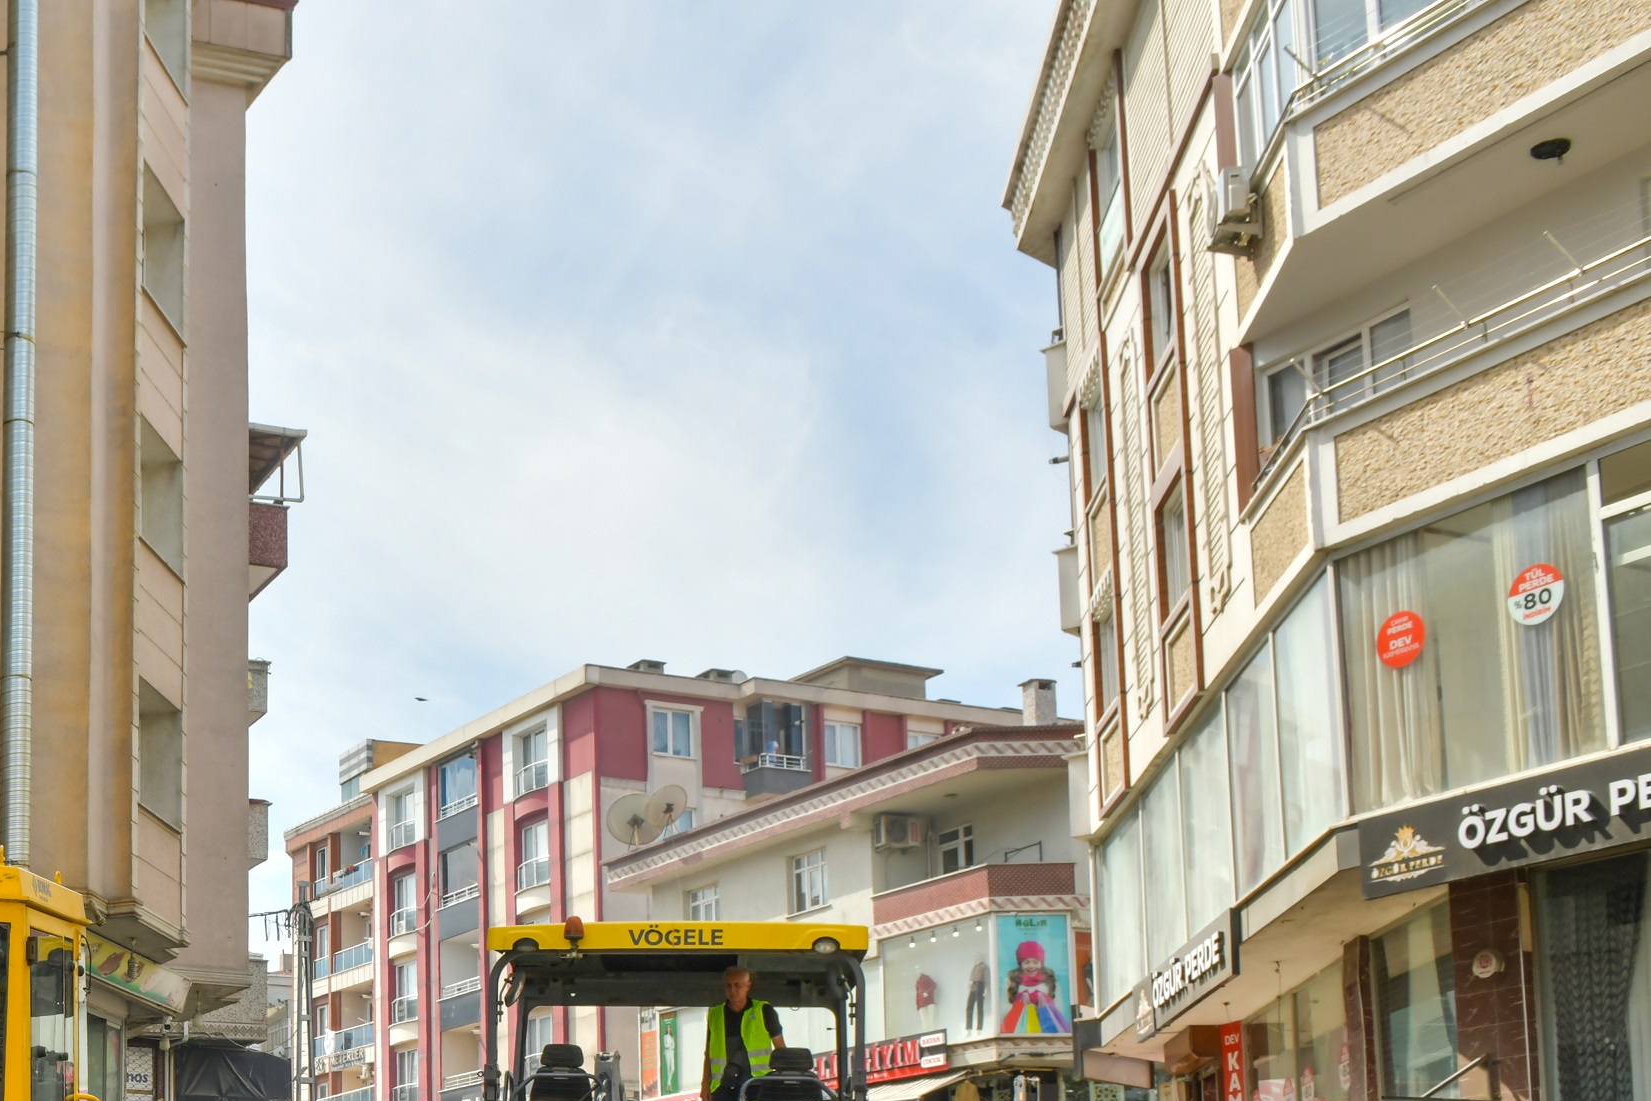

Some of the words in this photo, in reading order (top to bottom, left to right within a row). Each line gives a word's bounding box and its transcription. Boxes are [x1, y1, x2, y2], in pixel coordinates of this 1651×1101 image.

[1518, 573, 1554, 593] PERDE
[1524, 568, 1546, 581] TÜL
[1389, 634, 1412, 650] DEV
[1458, 784, 1594, 850] ÖZGÜR
[1371, 862, 1408, 881] ÖZGÜR
[1409, 853, 1444, 872] PERDE
[628, 924, 724, 946] VÖGELE
[1152, 956, 1184, 1009] ÖZGÜR
[1185, 931, 1220, 985] PERDE
[1224, 1033, 1240, 1046] DEV
[127, 1072, 148, 1083] nos
